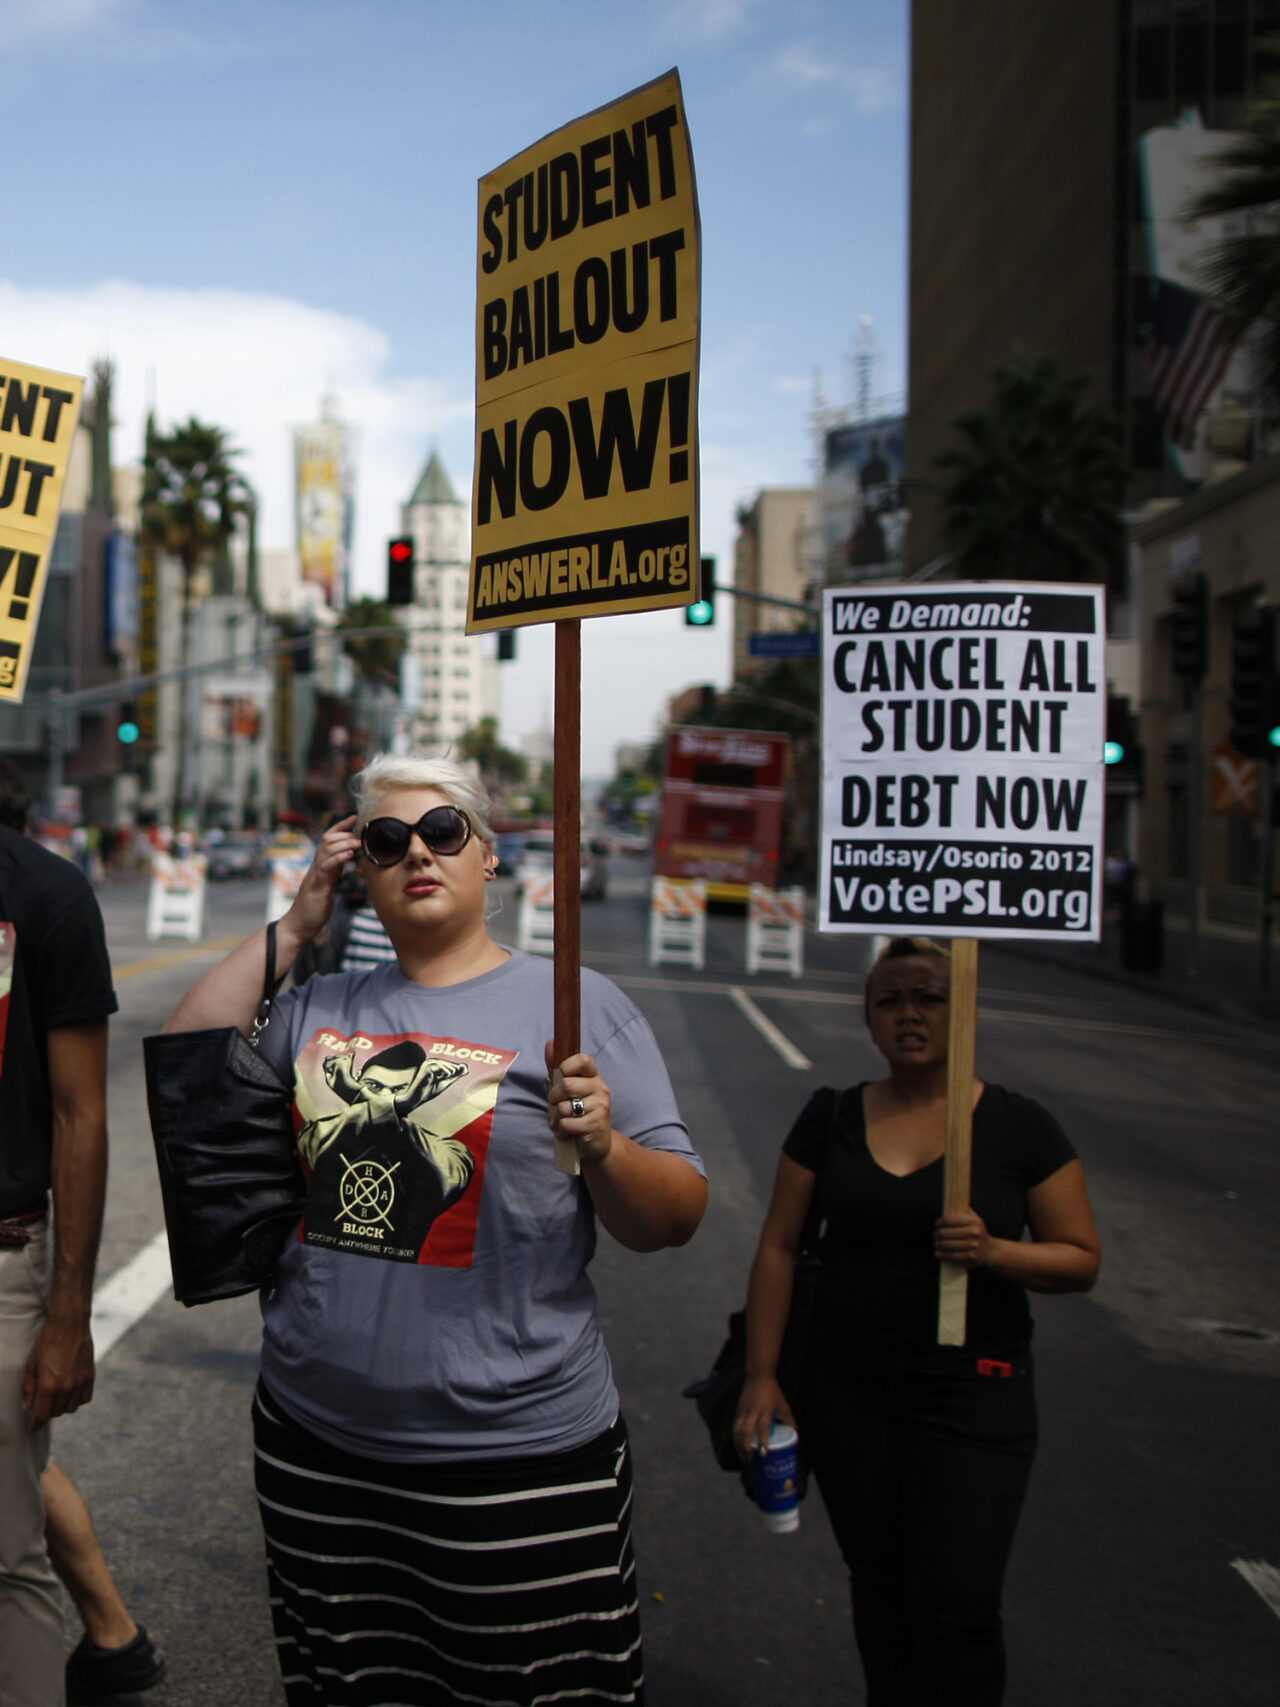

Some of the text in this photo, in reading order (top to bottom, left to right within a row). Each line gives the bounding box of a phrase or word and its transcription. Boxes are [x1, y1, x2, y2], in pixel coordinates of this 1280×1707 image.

[482, 103, 678, 275] STUDENT
[483, 227, 685, 382] BAILOUT
[476, 371, 691, 527] NOW!
[476, 540, 687, 608] ANSWERLA.org
[835, 595, 1032, 630] We Demand:
[833, 637, 1096, 693] CANCEL ALL
[861, 698, 1068, 753] STUDENT
[841, 775, 1088, 831] DEBT NOW
[832, 844, 1091, 873] Lindsay/Osorio 2012
[833, 877, 1089, 929] VotePSL.org
[429, 1042, 503, 1065] BLOCK
[342, 1222, 384, 1239] BLOCK
